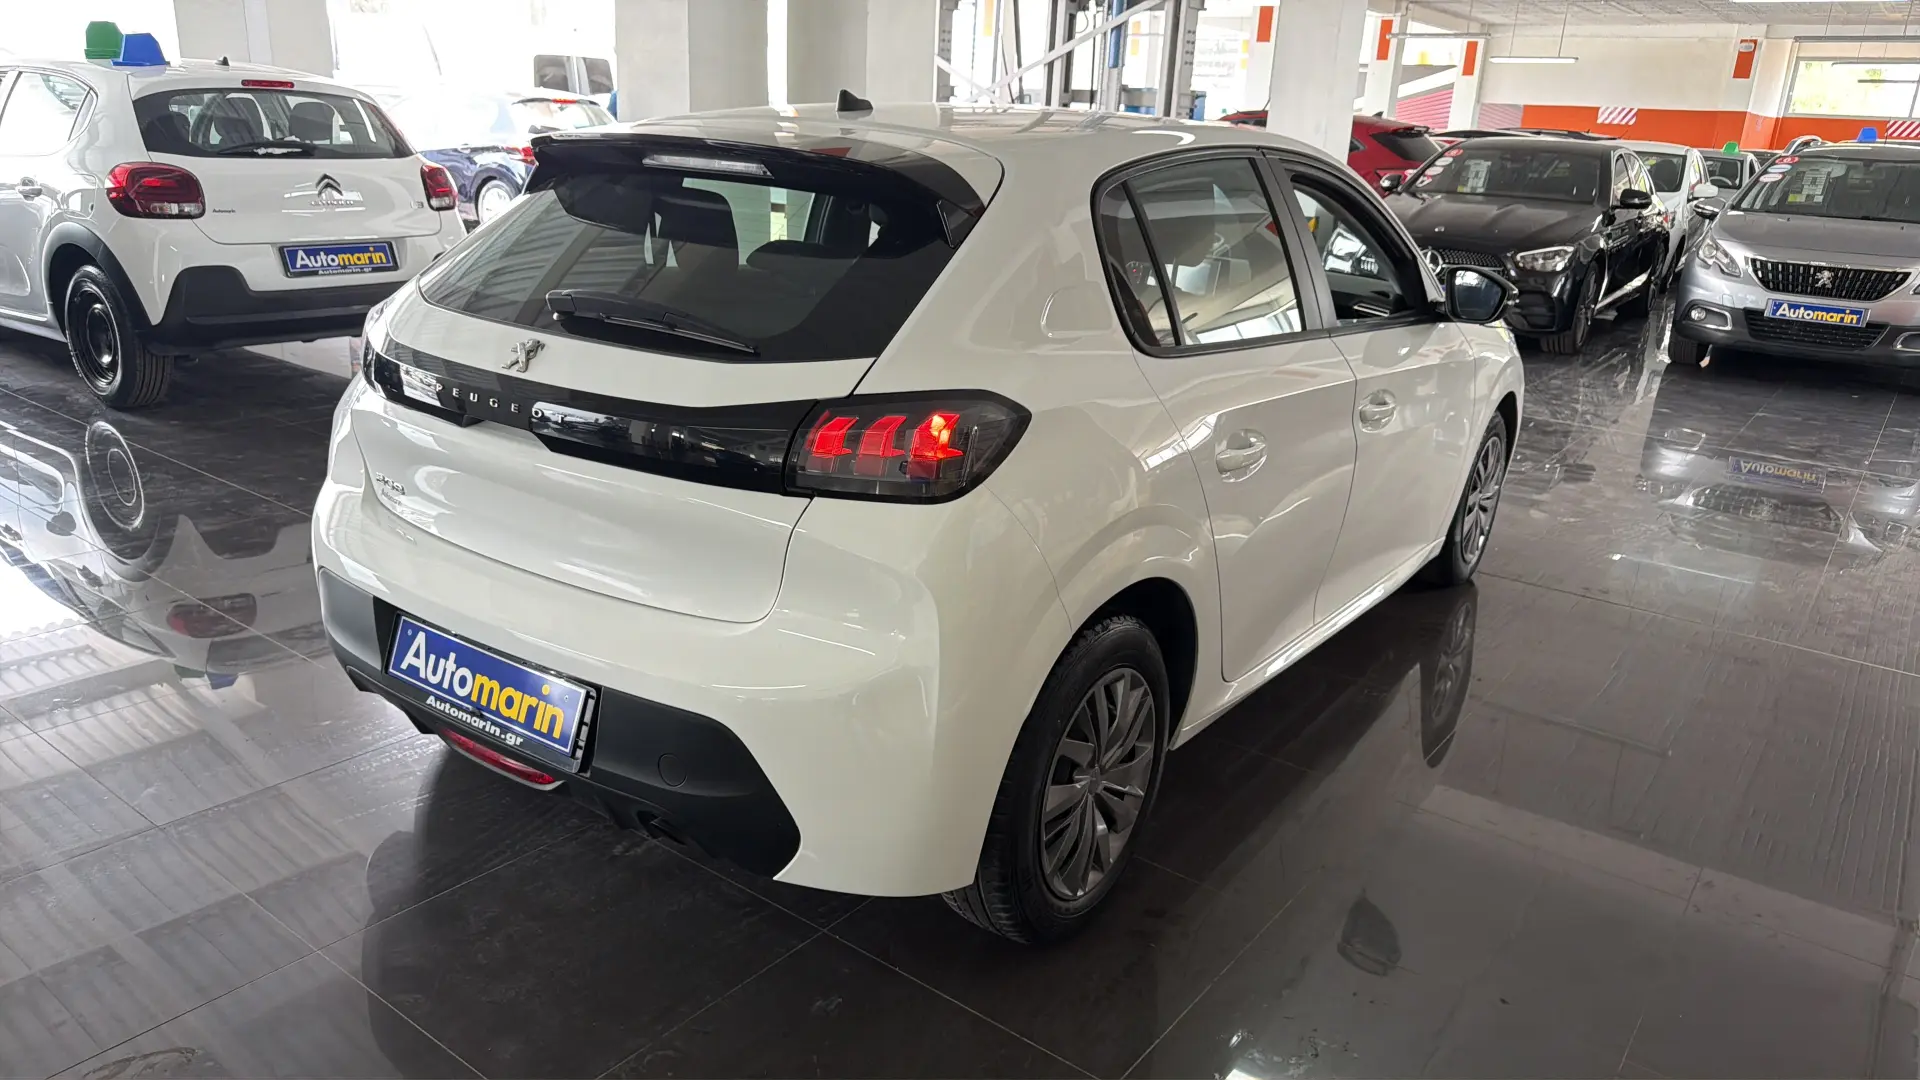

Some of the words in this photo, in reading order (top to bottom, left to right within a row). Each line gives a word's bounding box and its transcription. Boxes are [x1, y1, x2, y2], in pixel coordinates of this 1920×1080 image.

[296, 246, 386, 268] Automarin
[318, 267, 373, 275] Automarin.gr
[1776, 303, 1857, 324] Automarin
[435, 383, 565, 424] PEUGEOT
[400, 631, 565, 739] Automarin
[425, 695, 524, 747] Automarin.gr
